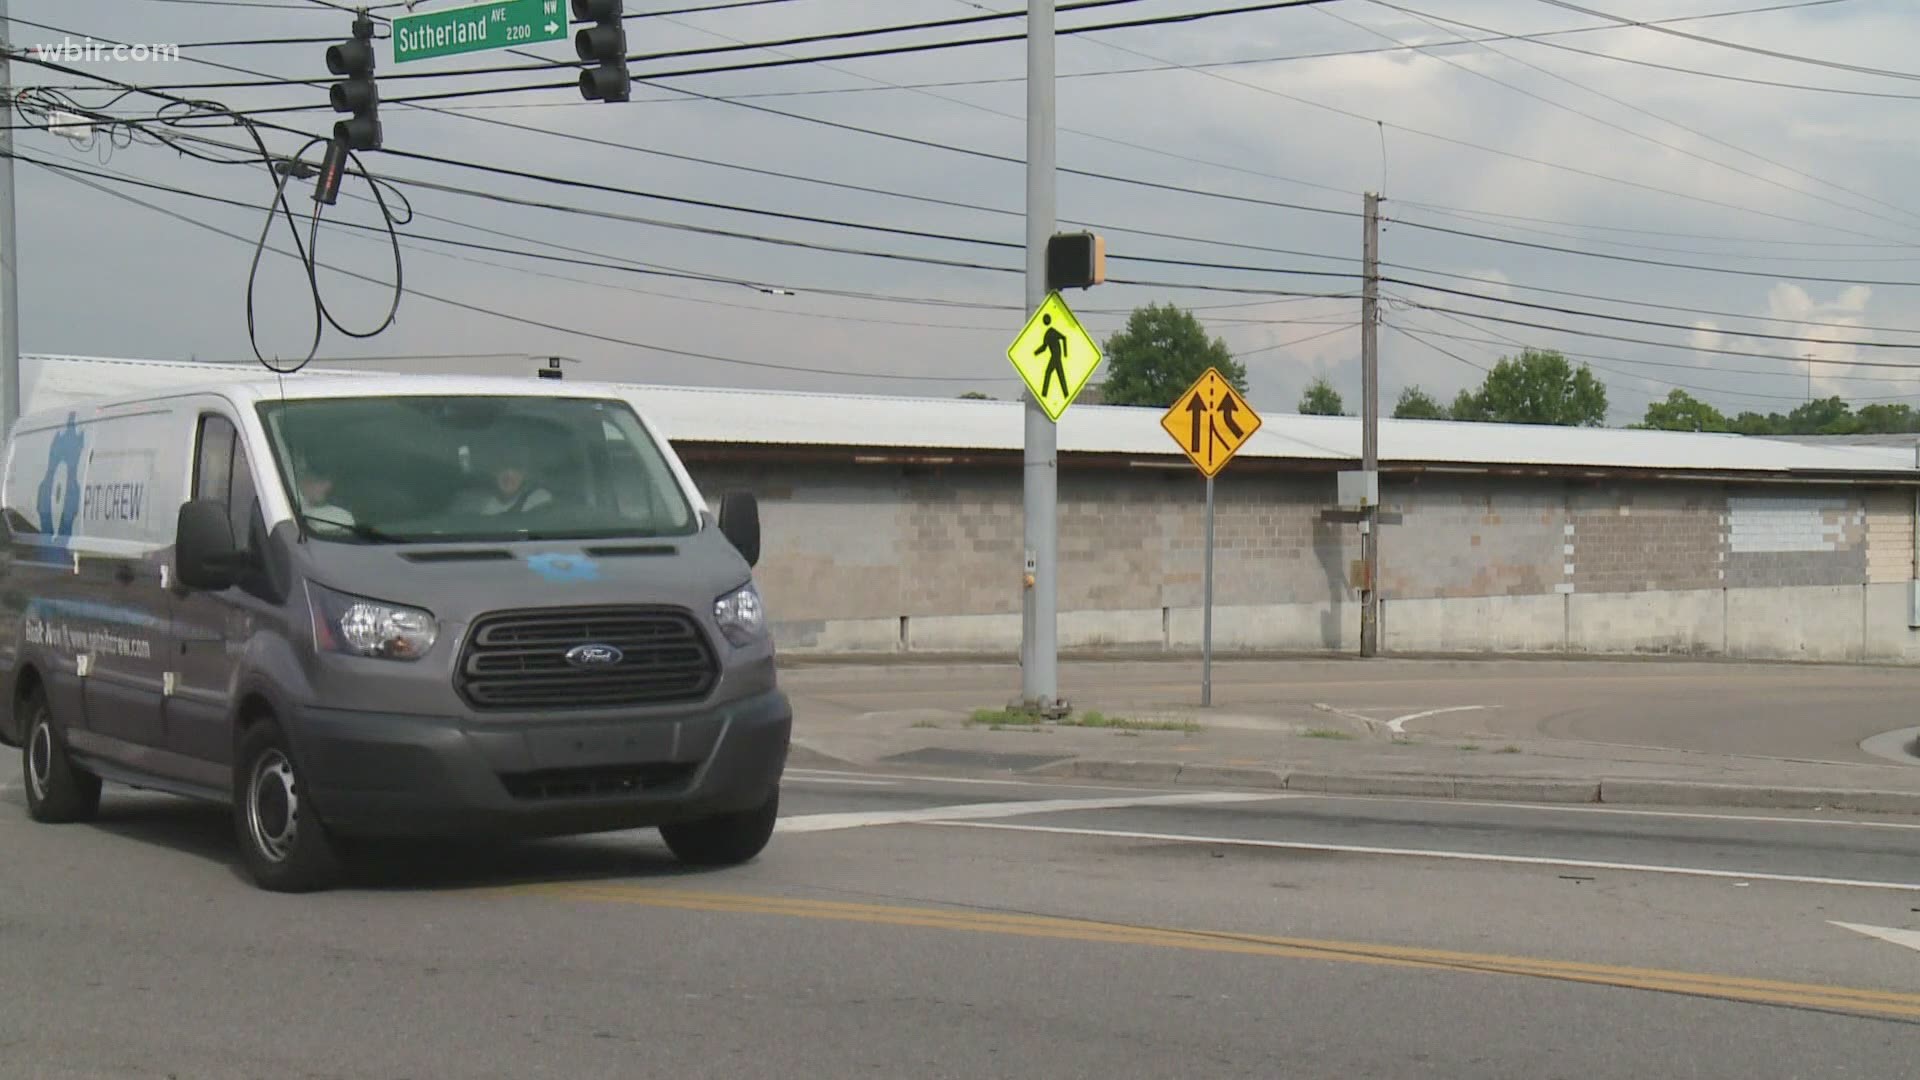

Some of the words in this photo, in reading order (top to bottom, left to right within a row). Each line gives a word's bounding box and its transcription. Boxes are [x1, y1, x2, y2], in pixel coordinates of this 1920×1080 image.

[399, 15, 487, 52] Sutherland
[490, 8, 507, 23] AVE
[543, 0, 558, 16] NW
[506, 24, 531, 41] 2200
[104, 481, 145, 521] CREW
